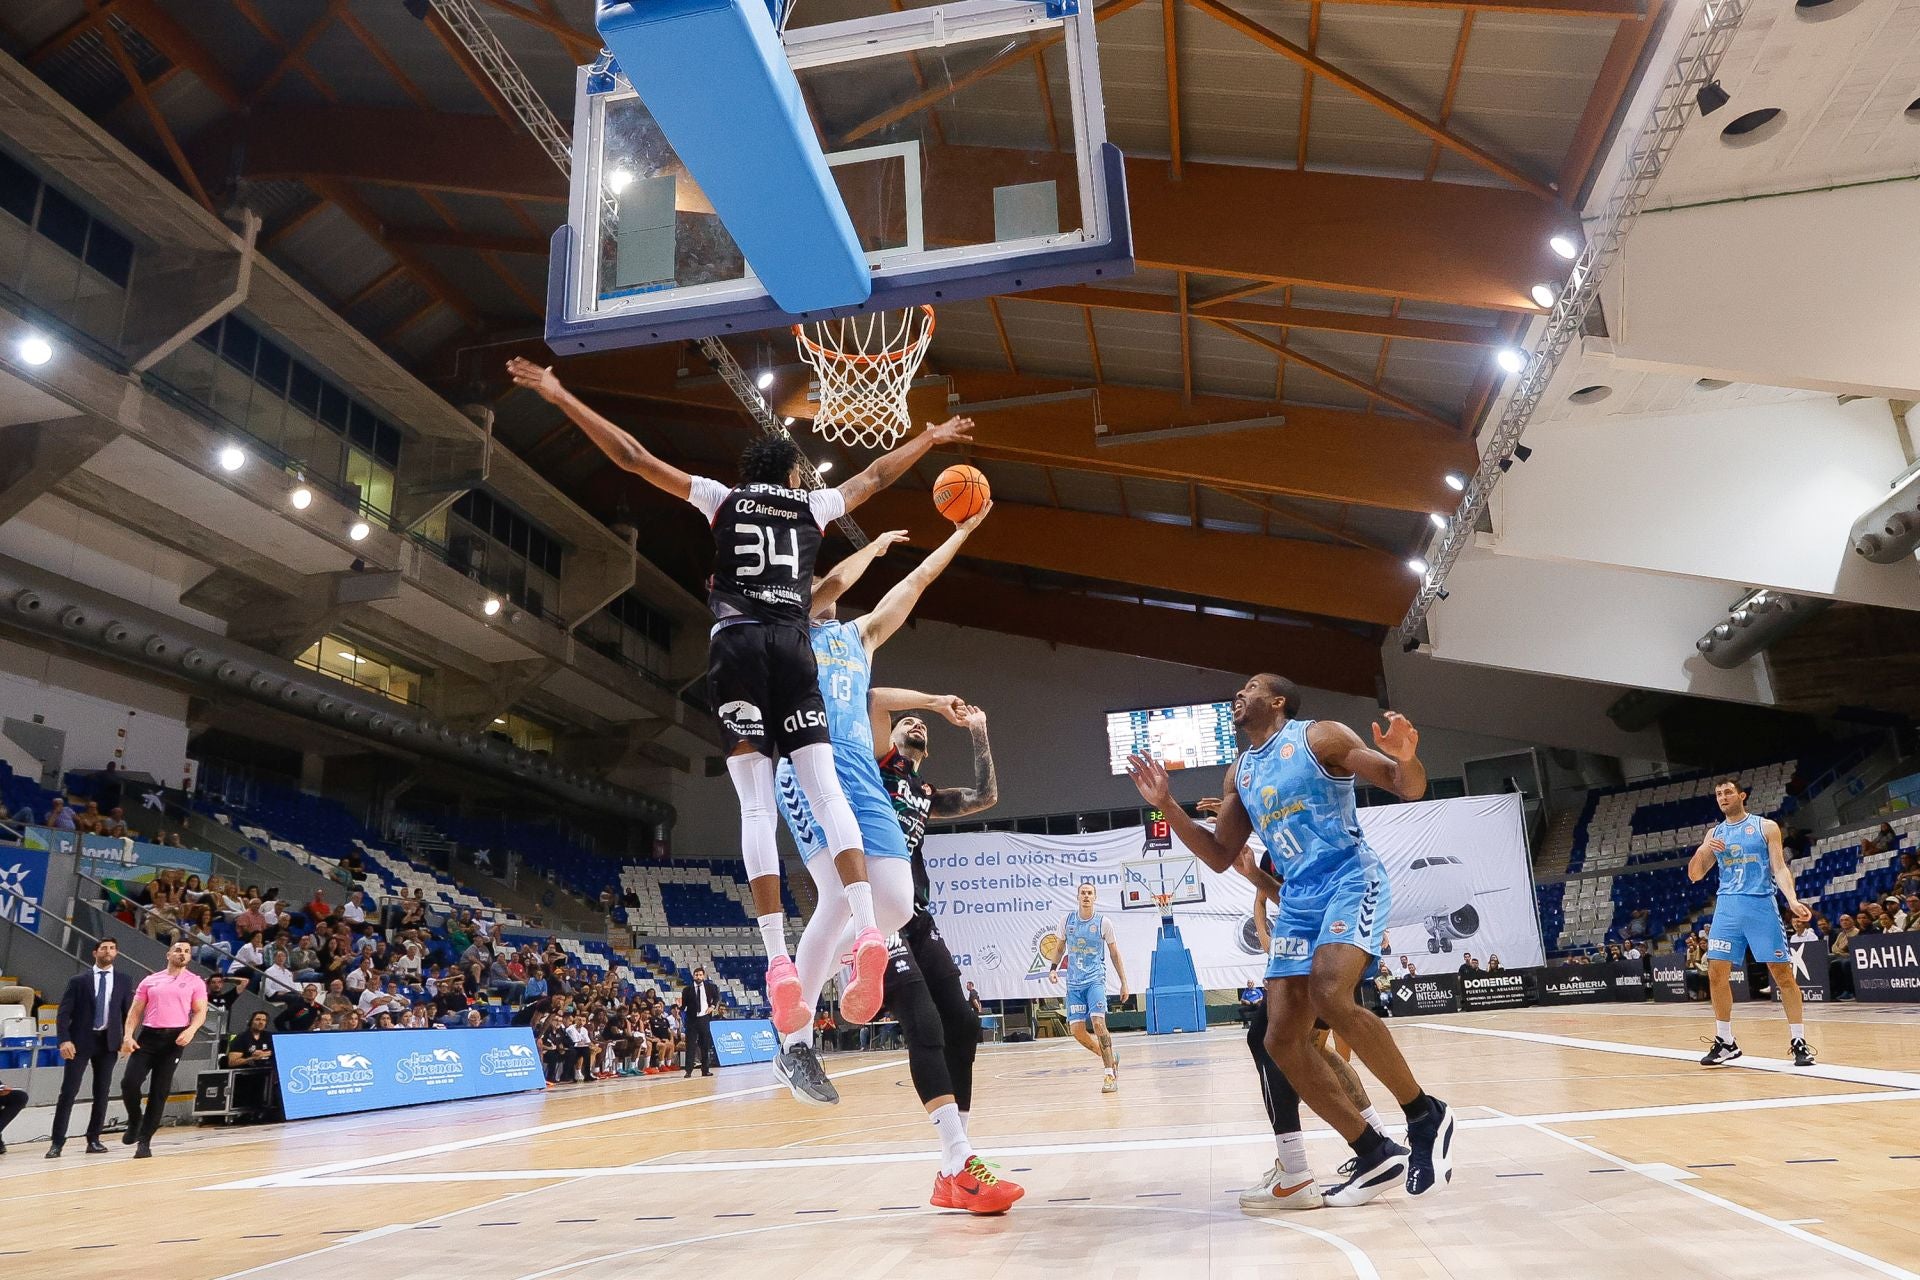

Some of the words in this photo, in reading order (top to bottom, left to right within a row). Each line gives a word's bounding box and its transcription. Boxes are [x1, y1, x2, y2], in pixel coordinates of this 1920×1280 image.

[750, 483, 808, 504] SPENCER
[734, 523, 799, 579] 34
[829, 672, 852, 702] 13
[1154, 821, 1167, 837] 13
[1272, 828, 1304, 859] 31
[974, 851, 1000, 866] del
[1006, 850, 1055, 865] avión
[1060, 850, 1098, 864] más
[934, 881, 945, 896] y
[950, 874, 1042, 891] sostenible
[1047, 872, 1074, 887] del
[953, 898, 1053, 915] Dreamliner
[1708, 939, 1732, 951] gaza
[1077, 957, 1085, 970] 5
[1855, 945, 1919, 970] BAHIA
[1414, 982, 1438, 992] ESPAIS
[1464, 976, 1523, 989] DOMENECH
[1559, 980, 1607, 990] BARBERIA
[1415, 990, 1453, 1001] INTEGRALS
[395, 1058, 463, 1084] Sirenas
[480, 1053, 536, 1076] Sirenas
[287, 1065, 374, 1094] Sirenas
